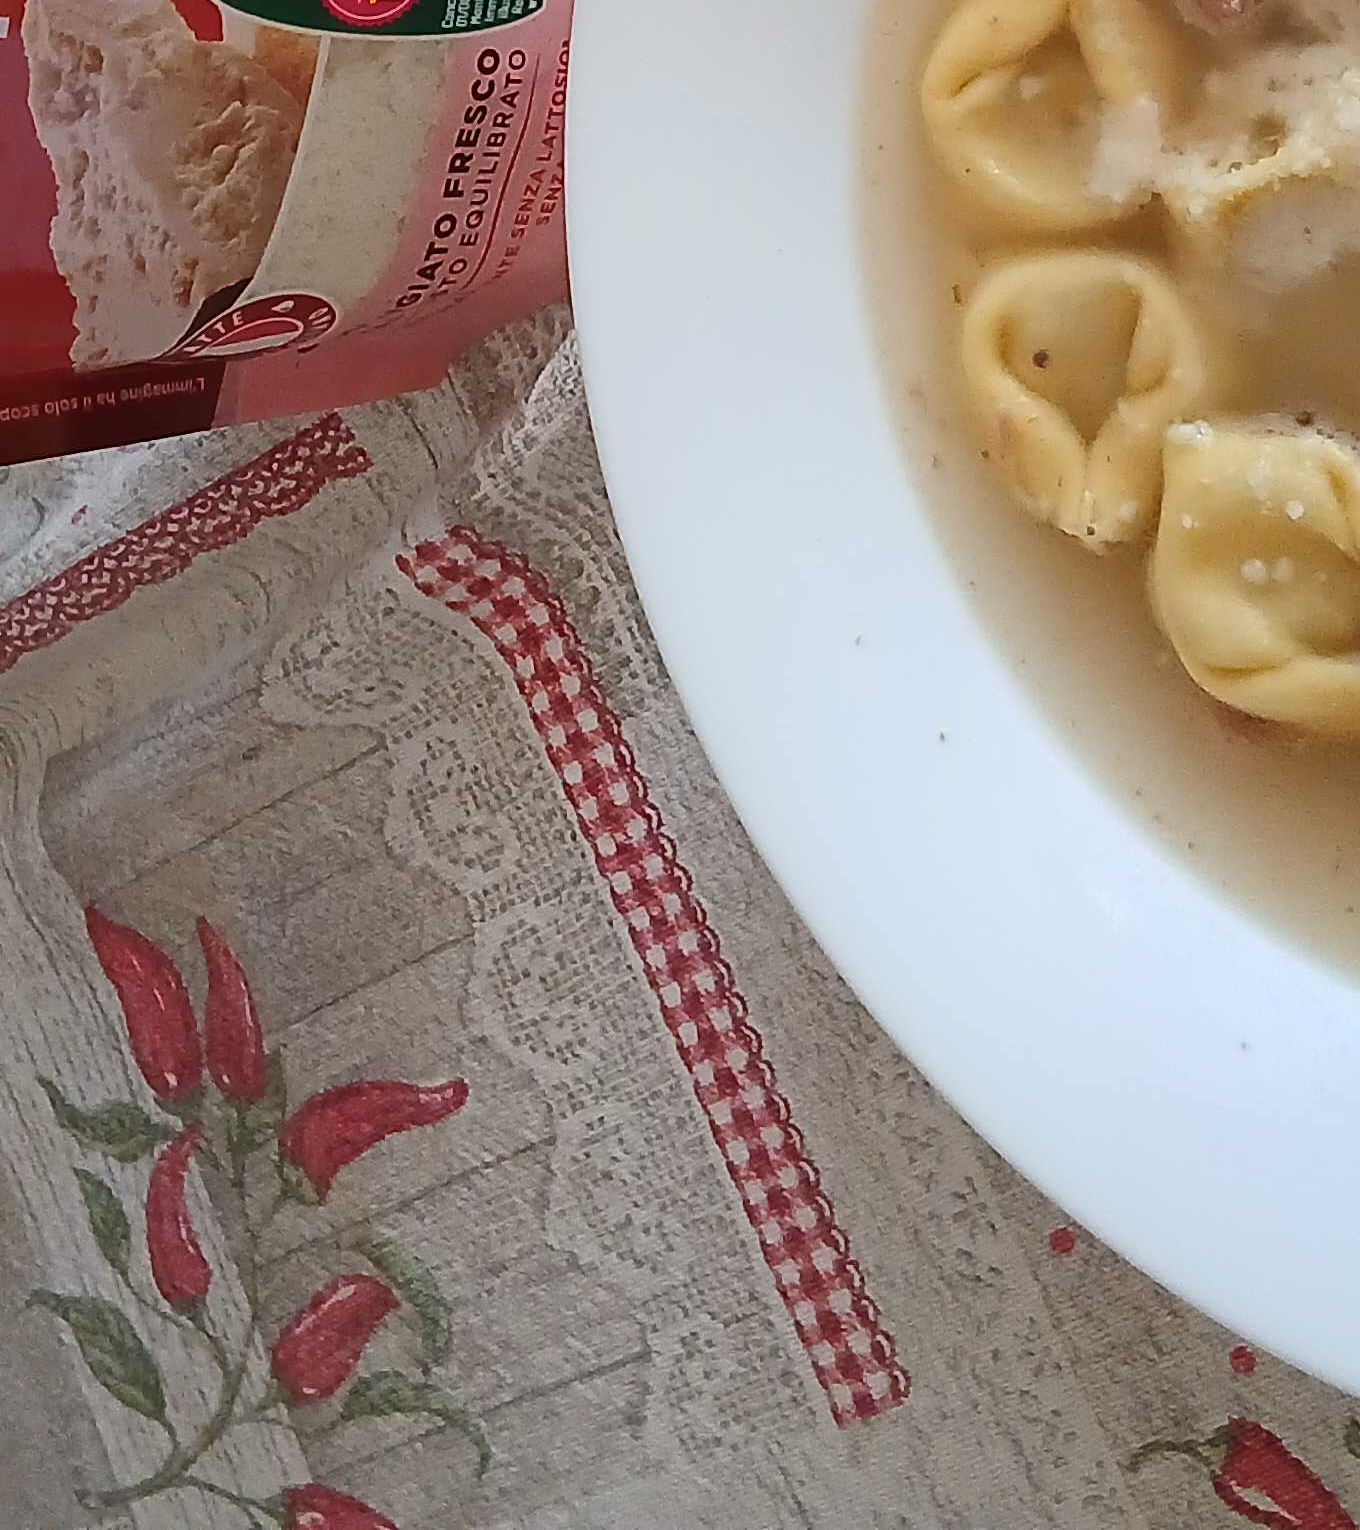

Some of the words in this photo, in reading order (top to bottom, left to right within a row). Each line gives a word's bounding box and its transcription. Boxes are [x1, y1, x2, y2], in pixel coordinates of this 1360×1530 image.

[441, 47, 501, 199] FRESCO
[459, 48, 527, 247] EQUILIBRATO
[510, 169, 546, 240] SENZA
[44, 397, 79, 416] solo
[96, 390, 116, 406] ha
[120, 376, 206, 401] L'immagine
